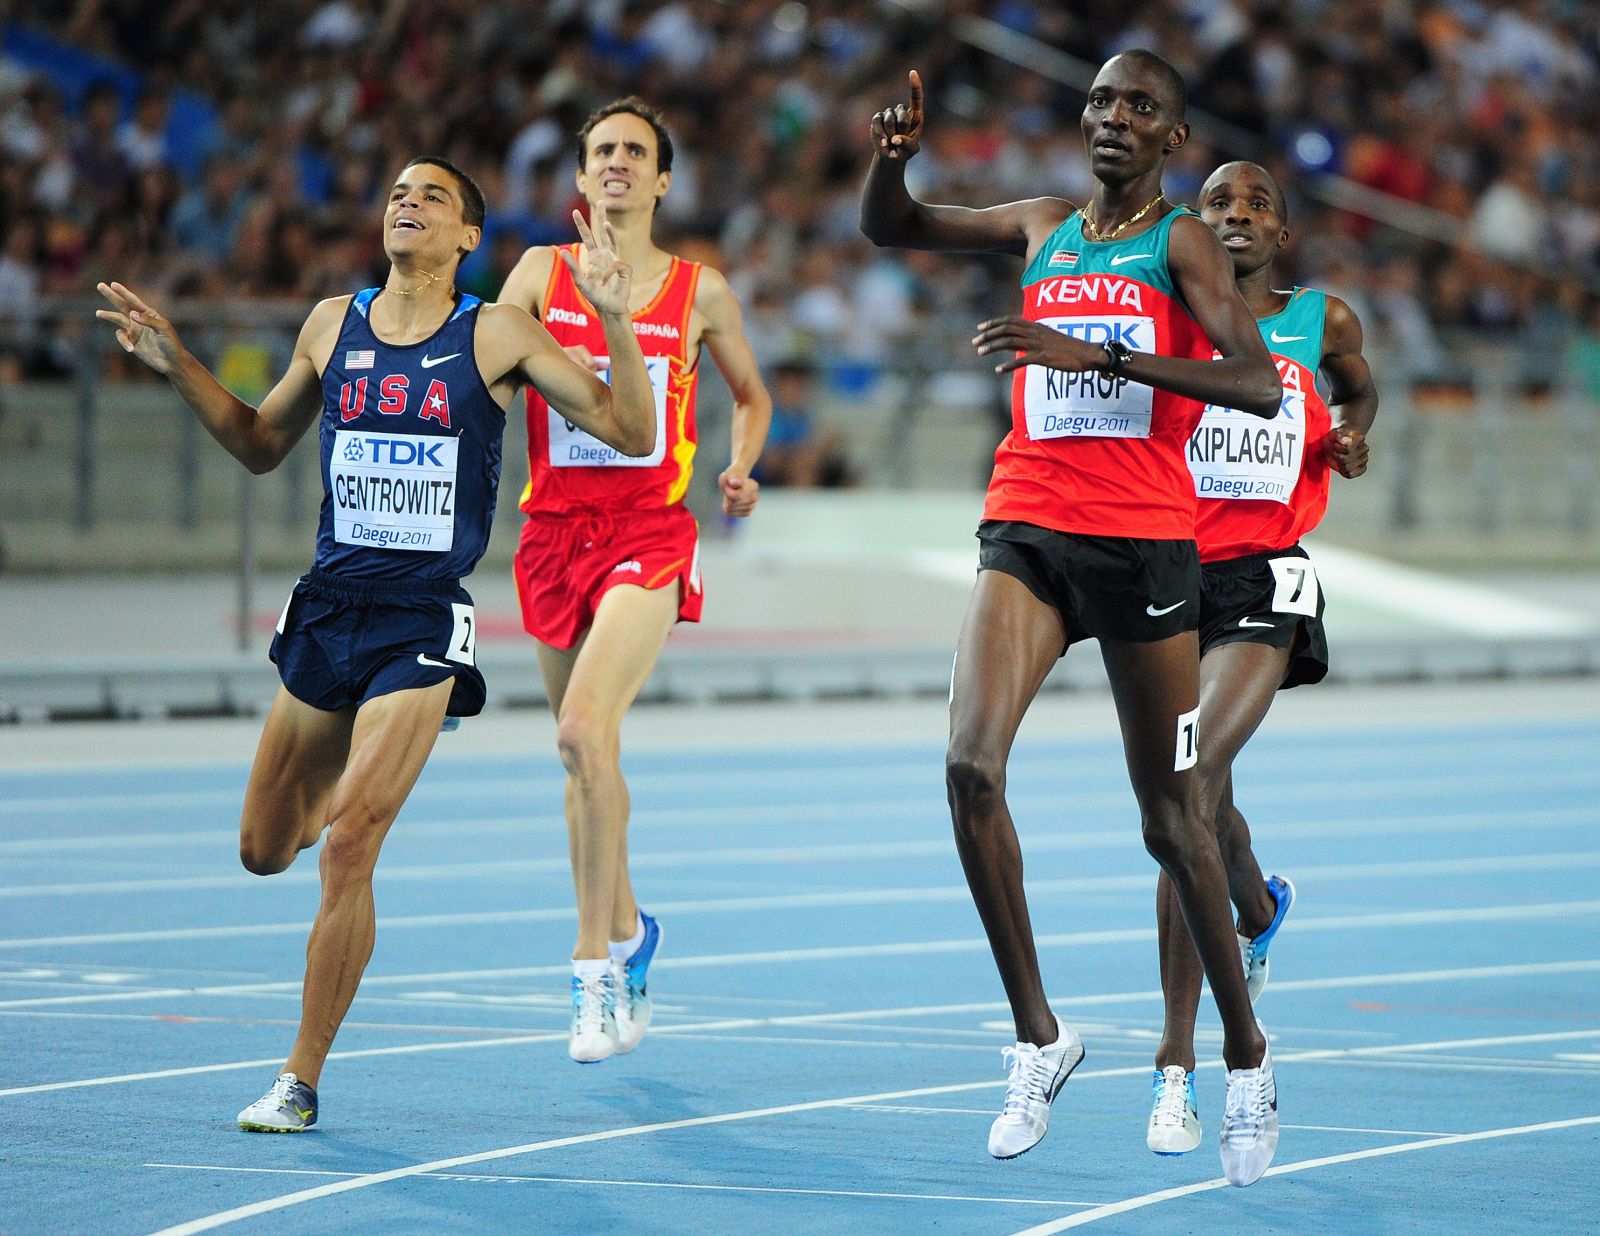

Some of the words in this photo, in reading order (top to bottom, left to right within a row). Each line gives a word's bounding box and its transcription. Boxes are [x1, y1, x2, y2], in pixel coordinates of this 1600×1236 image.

[1037, 277, 1143, 312] KENYA
[632, 321, 680, 339] ESPAÑA
[1057, 322, 1141, 349] TDK
[1046, 366, 1129, 401] KIPROP
[339, 374, 451, 428] USA
[1043, 415, 1096, 434] Daegu
[1097, 417, 1130, 432] 2011
[365, 438, 445, 467] TDK
[569, 445, 617, 464] Daegu
[1189, 427, 1297, 468] KIPLAGAT
[335, 473, 453, 516] CENTROWITZ
[1200, 476, 1254, 498] Daegu
[1255, 481, 1284, 496] 2011
[351, 523, 400, 546] Daegu
[401, 531, 433, 545] 2011
[1286, 567, 1306, 603] 7
[459, 616, 472, 653] 2
